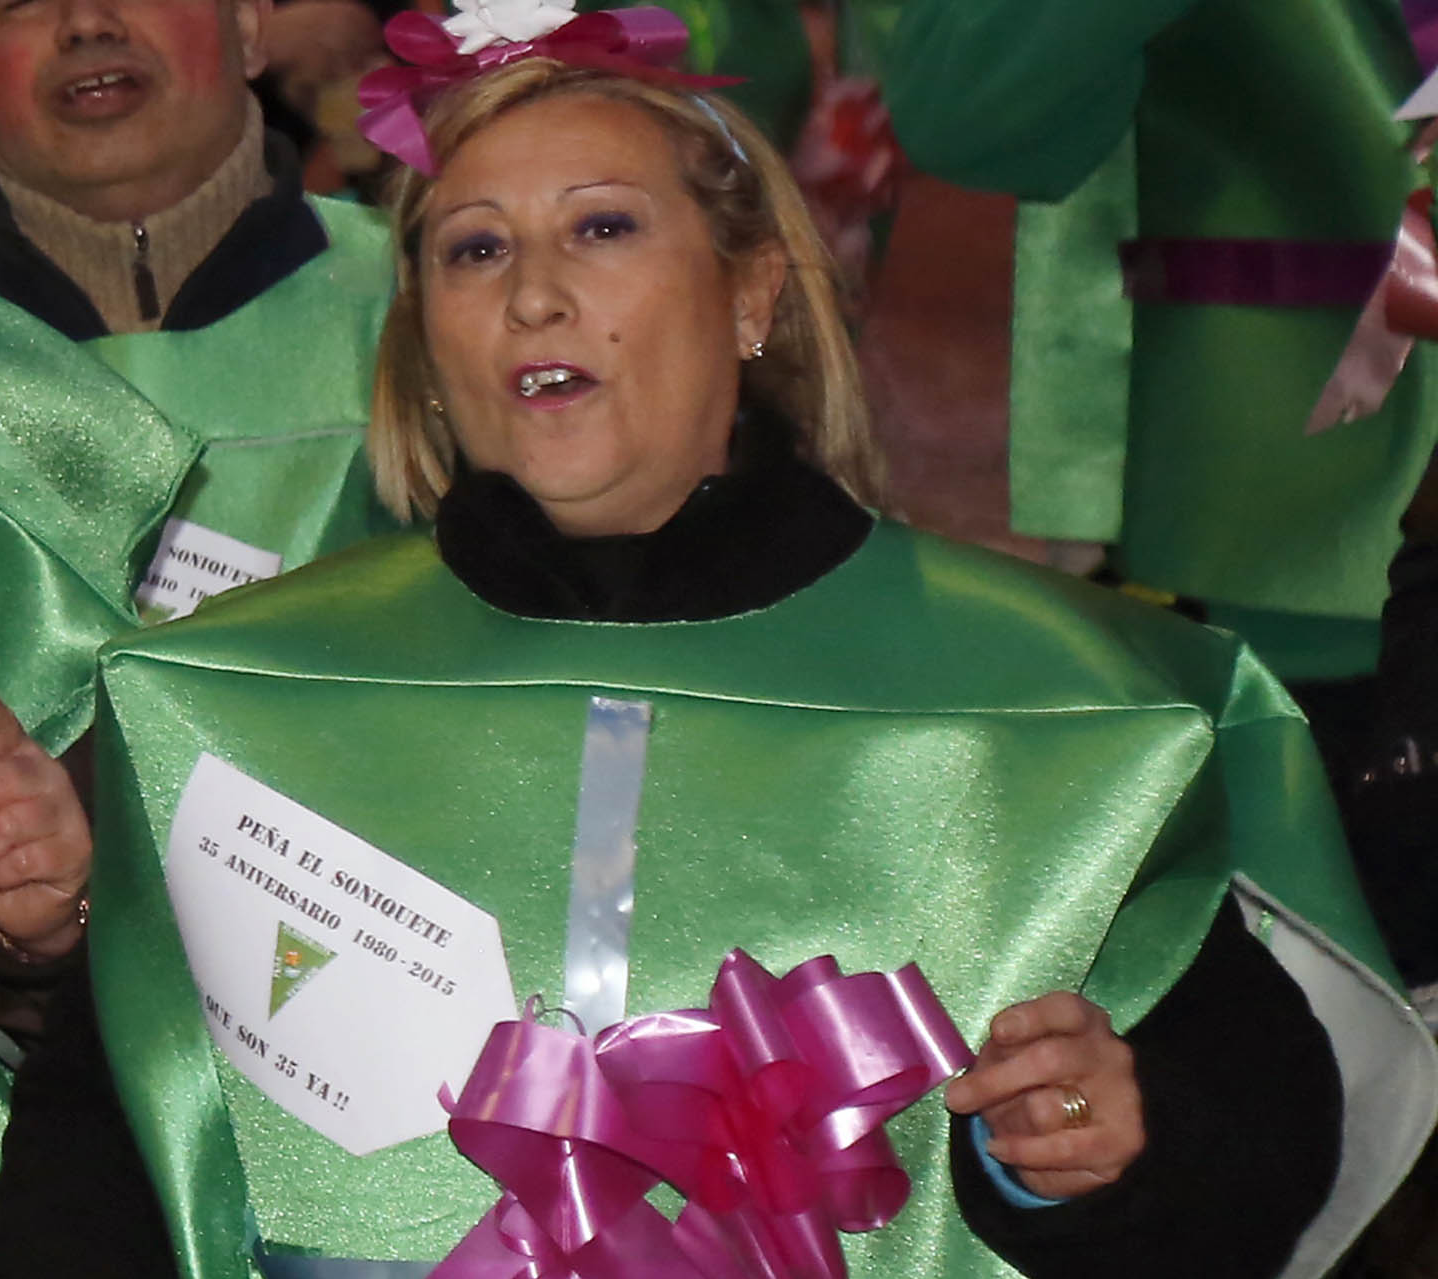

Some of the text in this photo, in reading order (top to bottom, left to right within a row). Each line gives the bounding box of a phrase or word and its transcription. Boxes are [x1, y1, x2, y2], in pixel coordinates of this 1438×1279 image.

[198, 836, 220, 858] 35
[224, 854, 341, 930] ANIVERSARIO
[236, 814, 290, 857] PEÑA
[297, 850, 323, 877] EL
[330, 870, 452, 948] SONIQUETE
[236, 1024, 269, 1058] SON
[274, 1053, 298, 1079] 35
